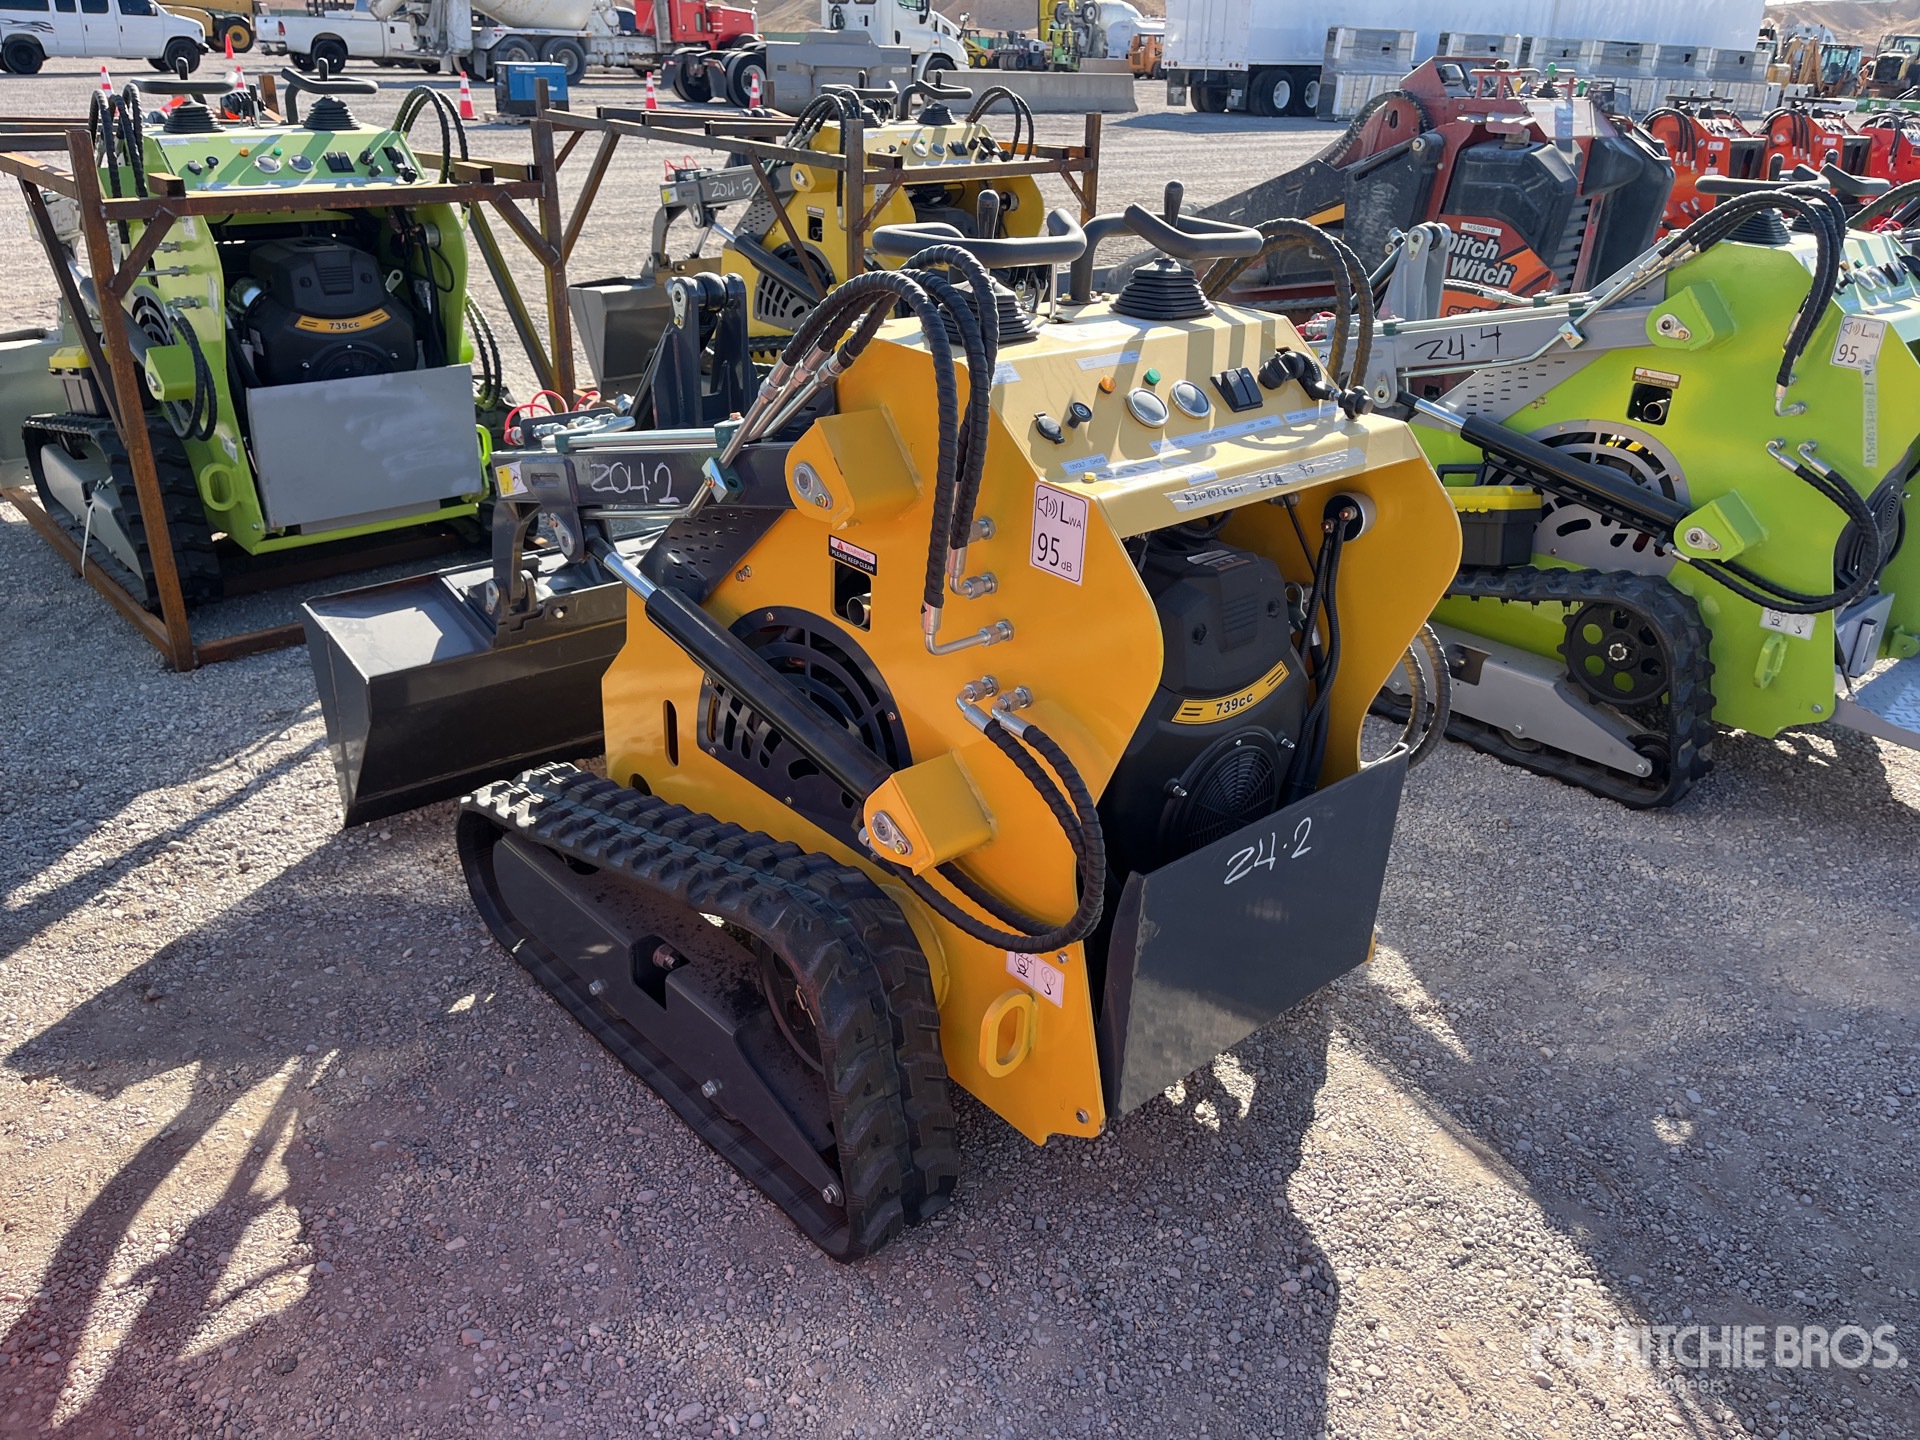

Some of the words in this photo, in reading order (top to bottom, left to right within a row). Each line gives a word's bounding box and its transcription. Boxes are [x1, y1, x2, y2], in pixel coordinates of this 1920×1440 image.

[1450, 257, 1512, 286] Witch
[329, 321, 360, 330] 739cc
[1837, 343, 1859, 363] 95
[845, 546, 871, 562] WARNING
[1037, 532, 1060, 566] 95
[831, 549, 847, 561] PLEASE
[847, 556, 860, 566] KEEP
[860, 561, 874, 573] CLEAR
[1061, 560, 1073, 572] dB
[1216, 693, 1253, 716] 739cc
